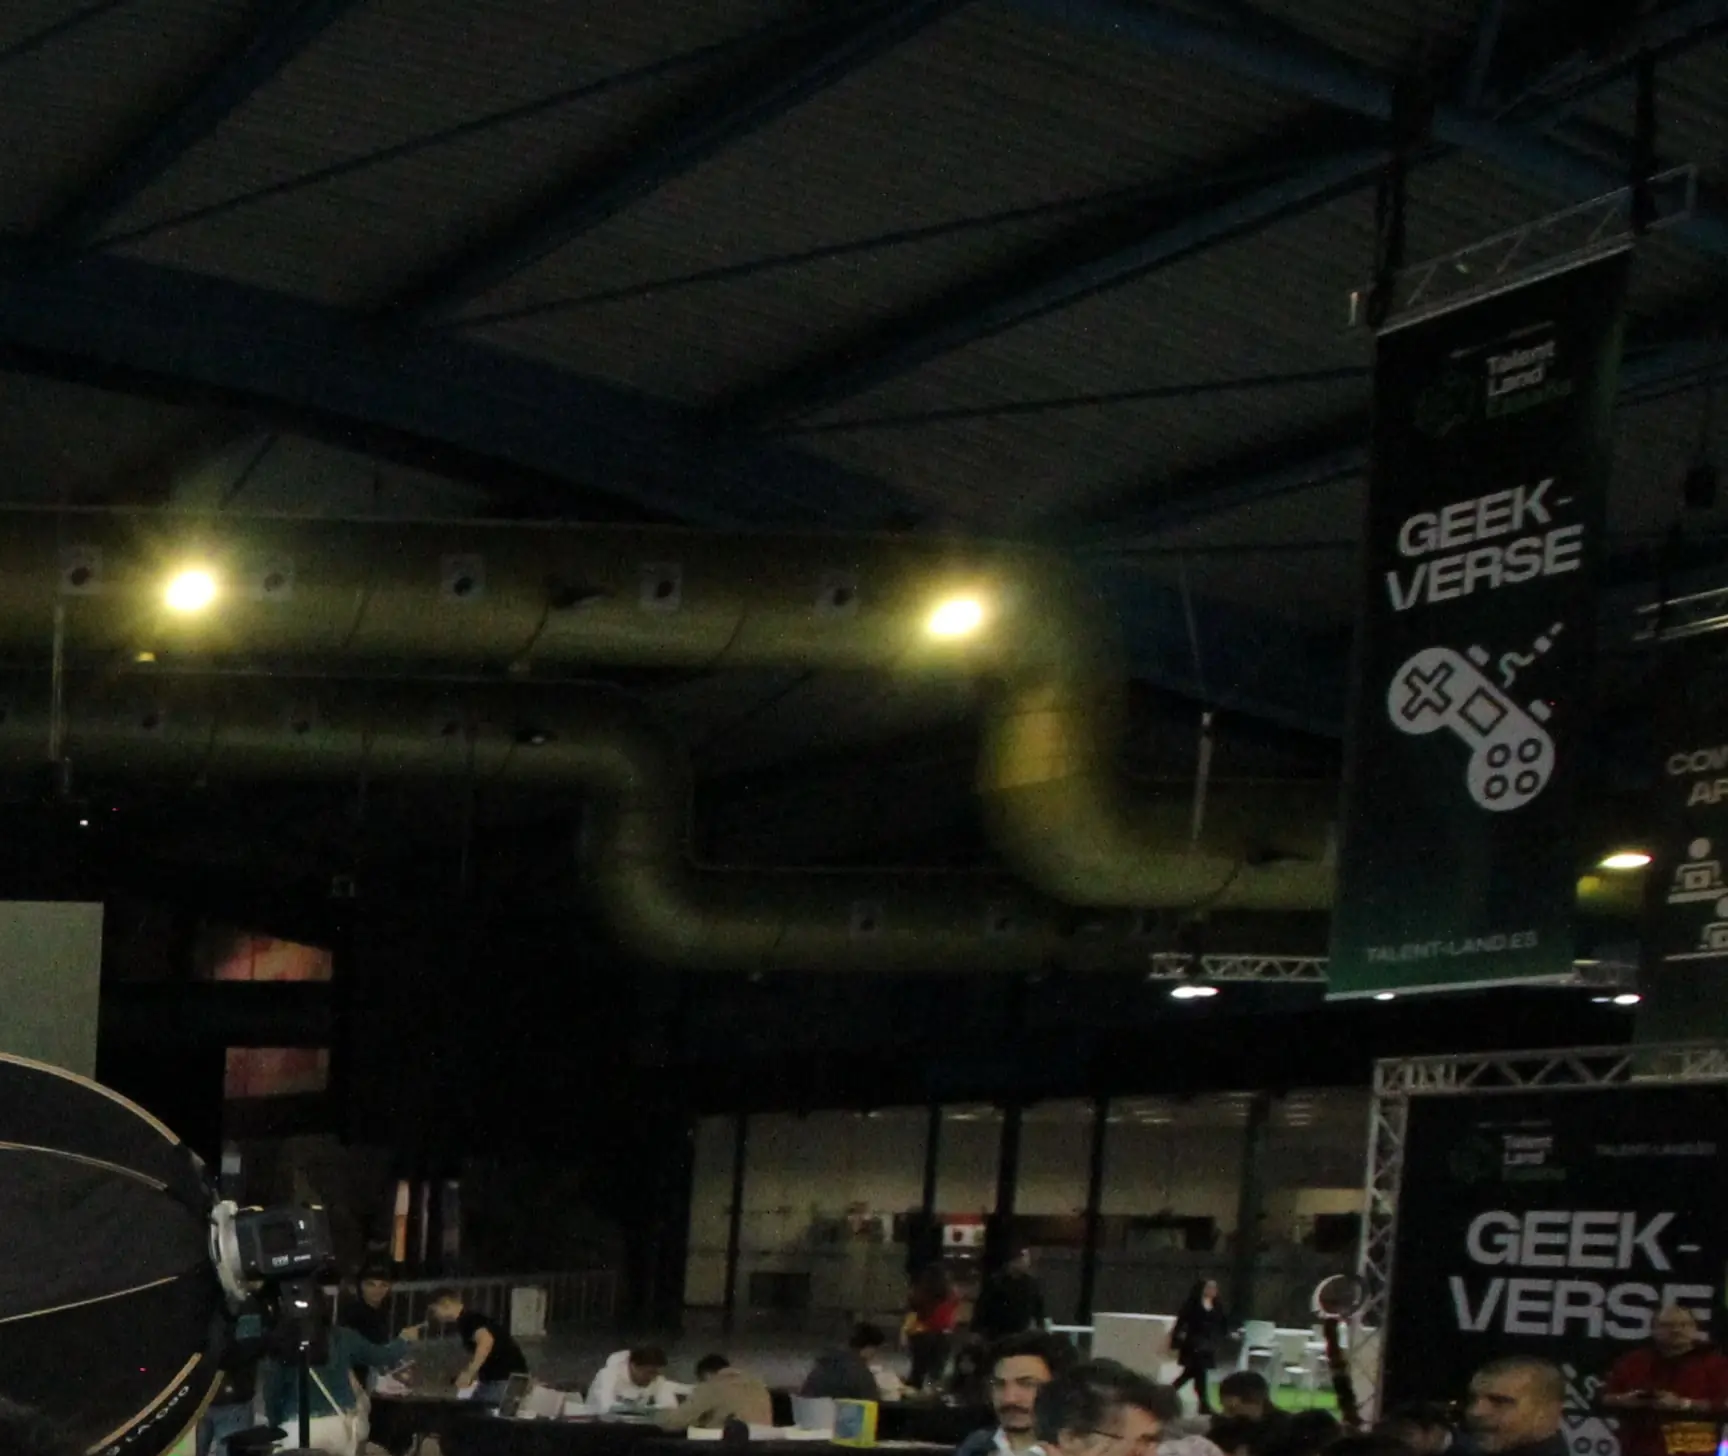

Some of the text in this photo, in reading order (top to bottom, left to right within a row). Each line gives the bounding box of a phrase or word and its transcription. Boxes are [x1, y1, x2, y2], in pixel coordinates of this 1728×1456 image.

[1398, 477, 1572, 558] GEEK-
[1386, 523, 1585, 612] VERSE
[1465, 1210, 1701, 1272] GEEK-
[1448, 1277, 1714, 1343] VERSE
